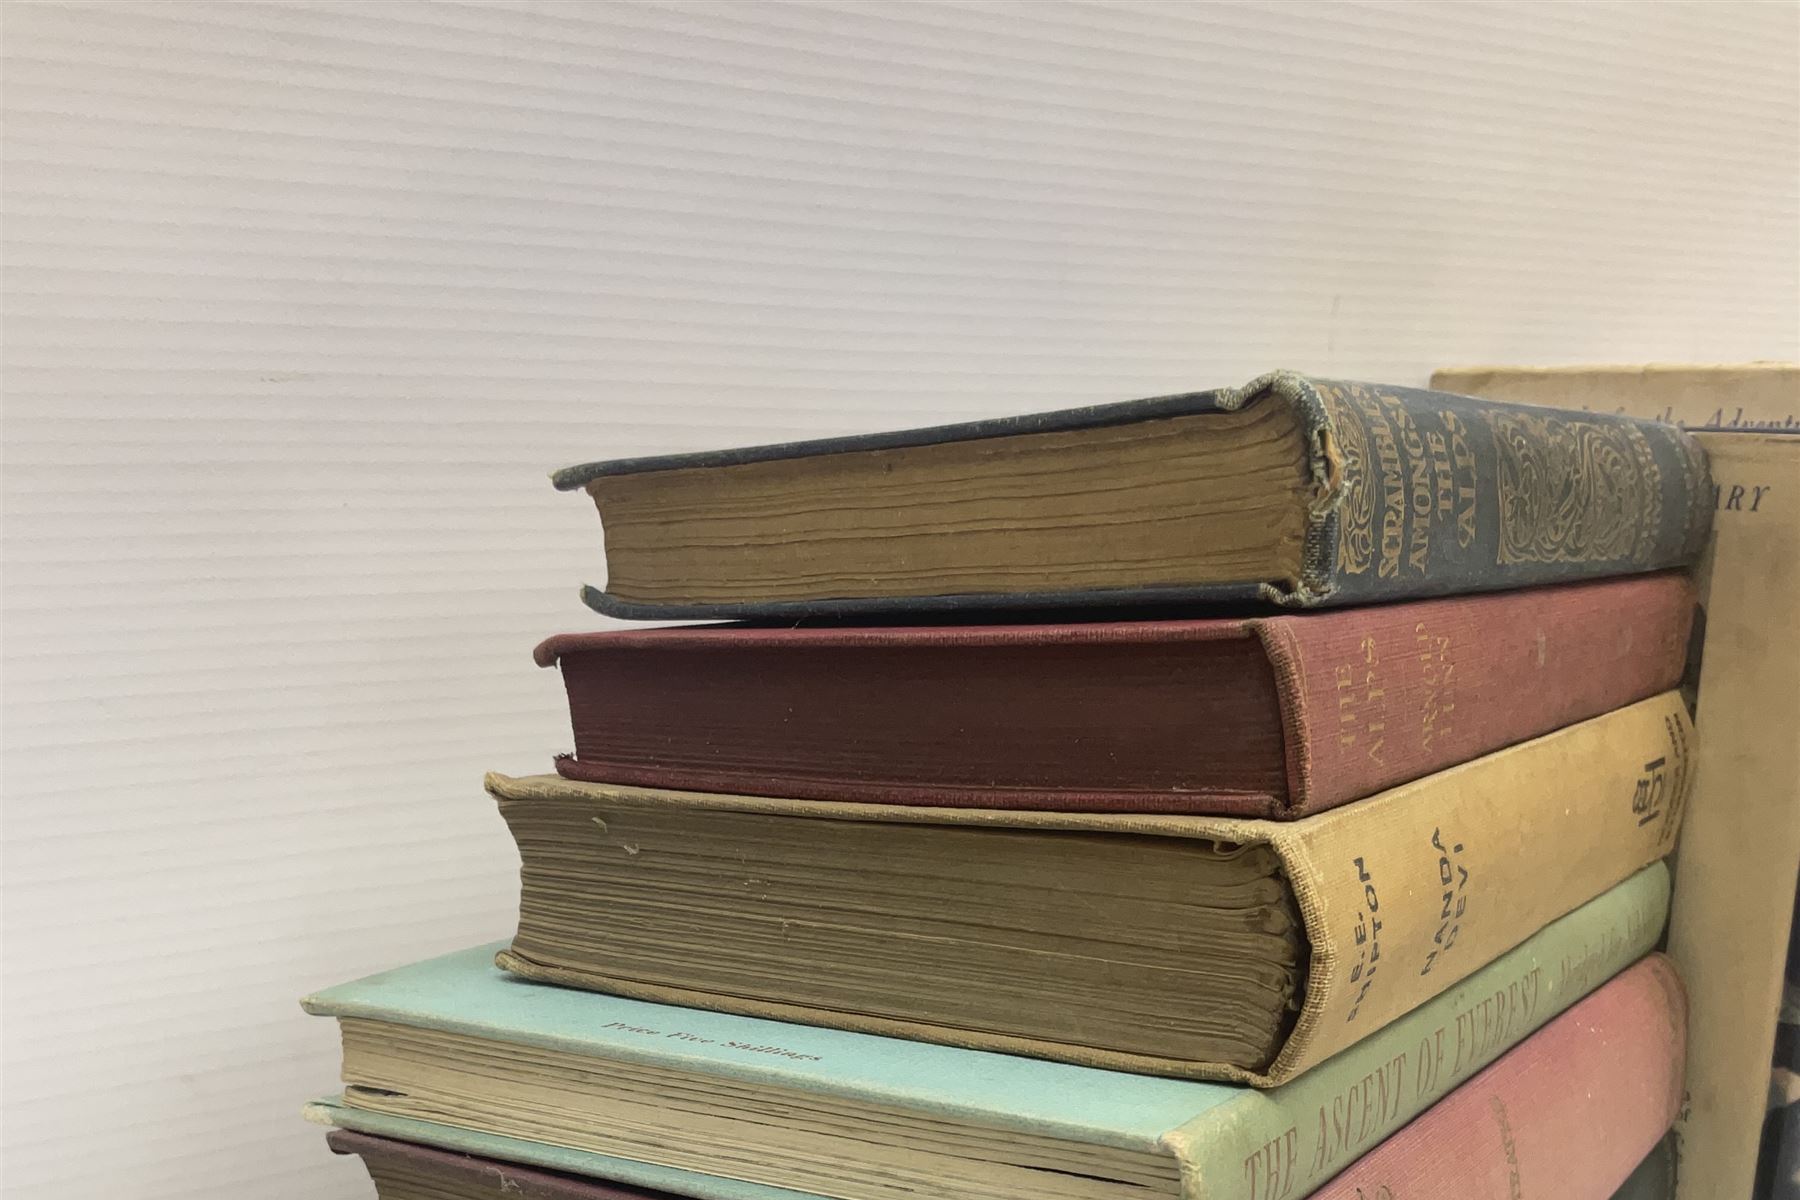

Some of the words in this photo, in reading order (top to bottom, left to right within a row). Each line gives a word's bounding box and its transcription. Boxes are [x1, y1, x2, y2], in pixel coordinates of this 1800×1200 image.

[1351, 385, 1405, 578] SCRAMBLES
[1375, 388, 1432, 576] AMONGST
[1424, 431, 1454, 522] THE
[1438, 410, 1477, 549] ALPS
[1361, 636, 1385, 768] ALPS
[1347, 856, 1383, 1024] SHIPTON
[1421, 826, 1453, 976] NANDA
[1444, 843, 1469, 951] DEVI
[601, 1021, 661, 1035] Price
[667, 1031, 715, 1045] Five
[720, 1040, 823, 1062] Shillings
[1309, 1053, 1407, 1178] ASCENT
[1417, 1027, 1446, 1098] OF
[1452, 966, 1542, 1078] EVEREST
